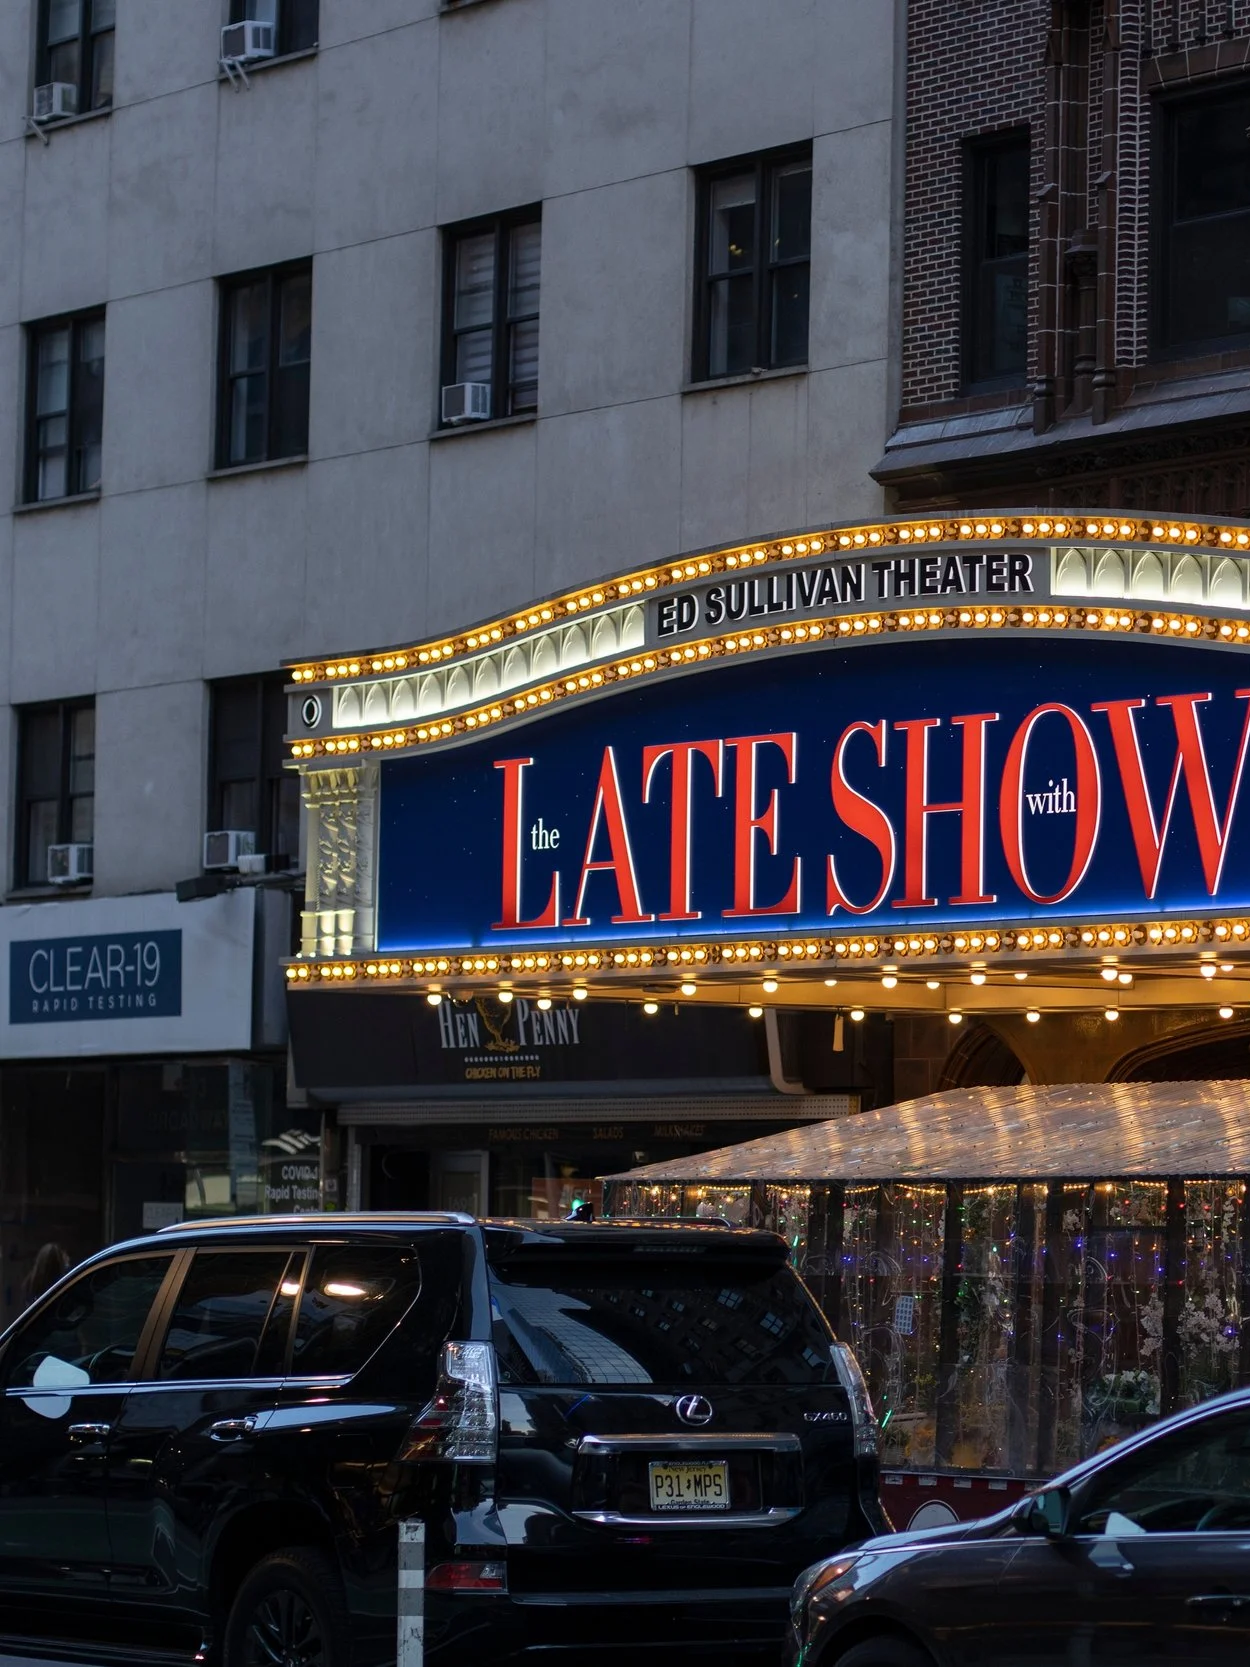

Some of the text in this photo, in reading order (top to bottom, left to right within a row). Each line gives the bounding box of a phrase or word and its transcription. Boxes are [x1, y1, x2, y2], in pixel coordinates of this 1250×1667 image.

[657, 553, 1034, 637] ED SULLIVAN THEATER
[1025, 779, 1077, 816] with
[491, 731, 801, 930] LATE
[530, 817, 560, 850] the
[28, 941, 161, 994] CLEAR-19
[32, 994, 157, 1013] RAPID TESTING
[438, 998, 581, 1048] HEN PENNY
[265, 1183, 290, 1203] Rapid
